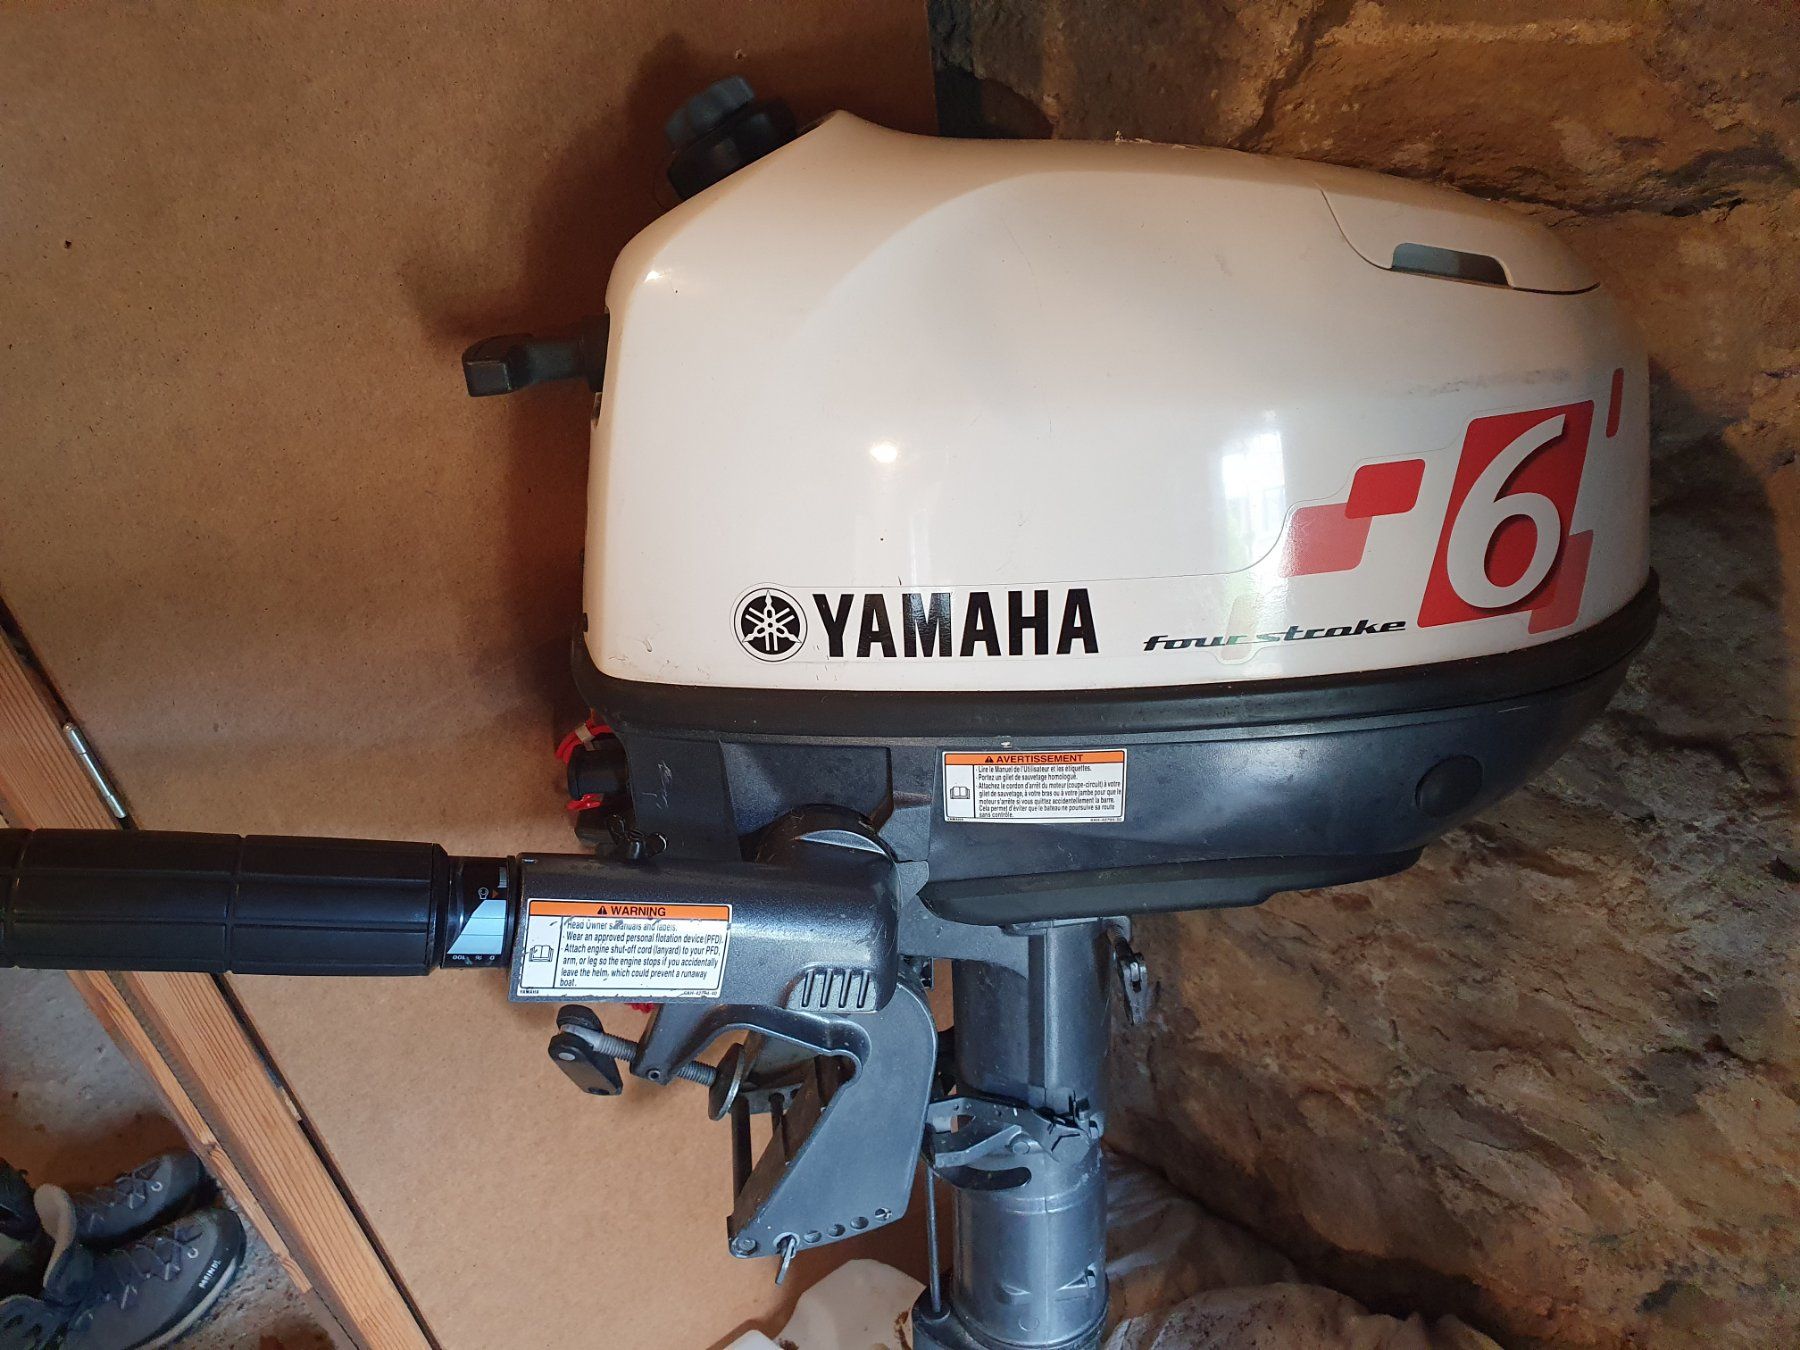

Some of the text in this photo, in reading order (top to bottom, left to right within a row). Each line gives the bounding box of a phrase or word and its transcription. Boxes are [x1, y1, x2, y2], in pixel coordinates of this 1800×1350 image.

[1446, 414, 1566, 609] 6
[813, 588, 1098, 658] YAMAHA
[996, 755, 1083, 763] AVERTISSEMENT
[611, 906, 666, 916] WARNING
[595, 933, 624, 942] approved
[626, 934, 653, 944] personal
[611, 943, 637, 954] shut-off
[609, 957, 618, 965] the
[560, 978, 576, 986] boat.
